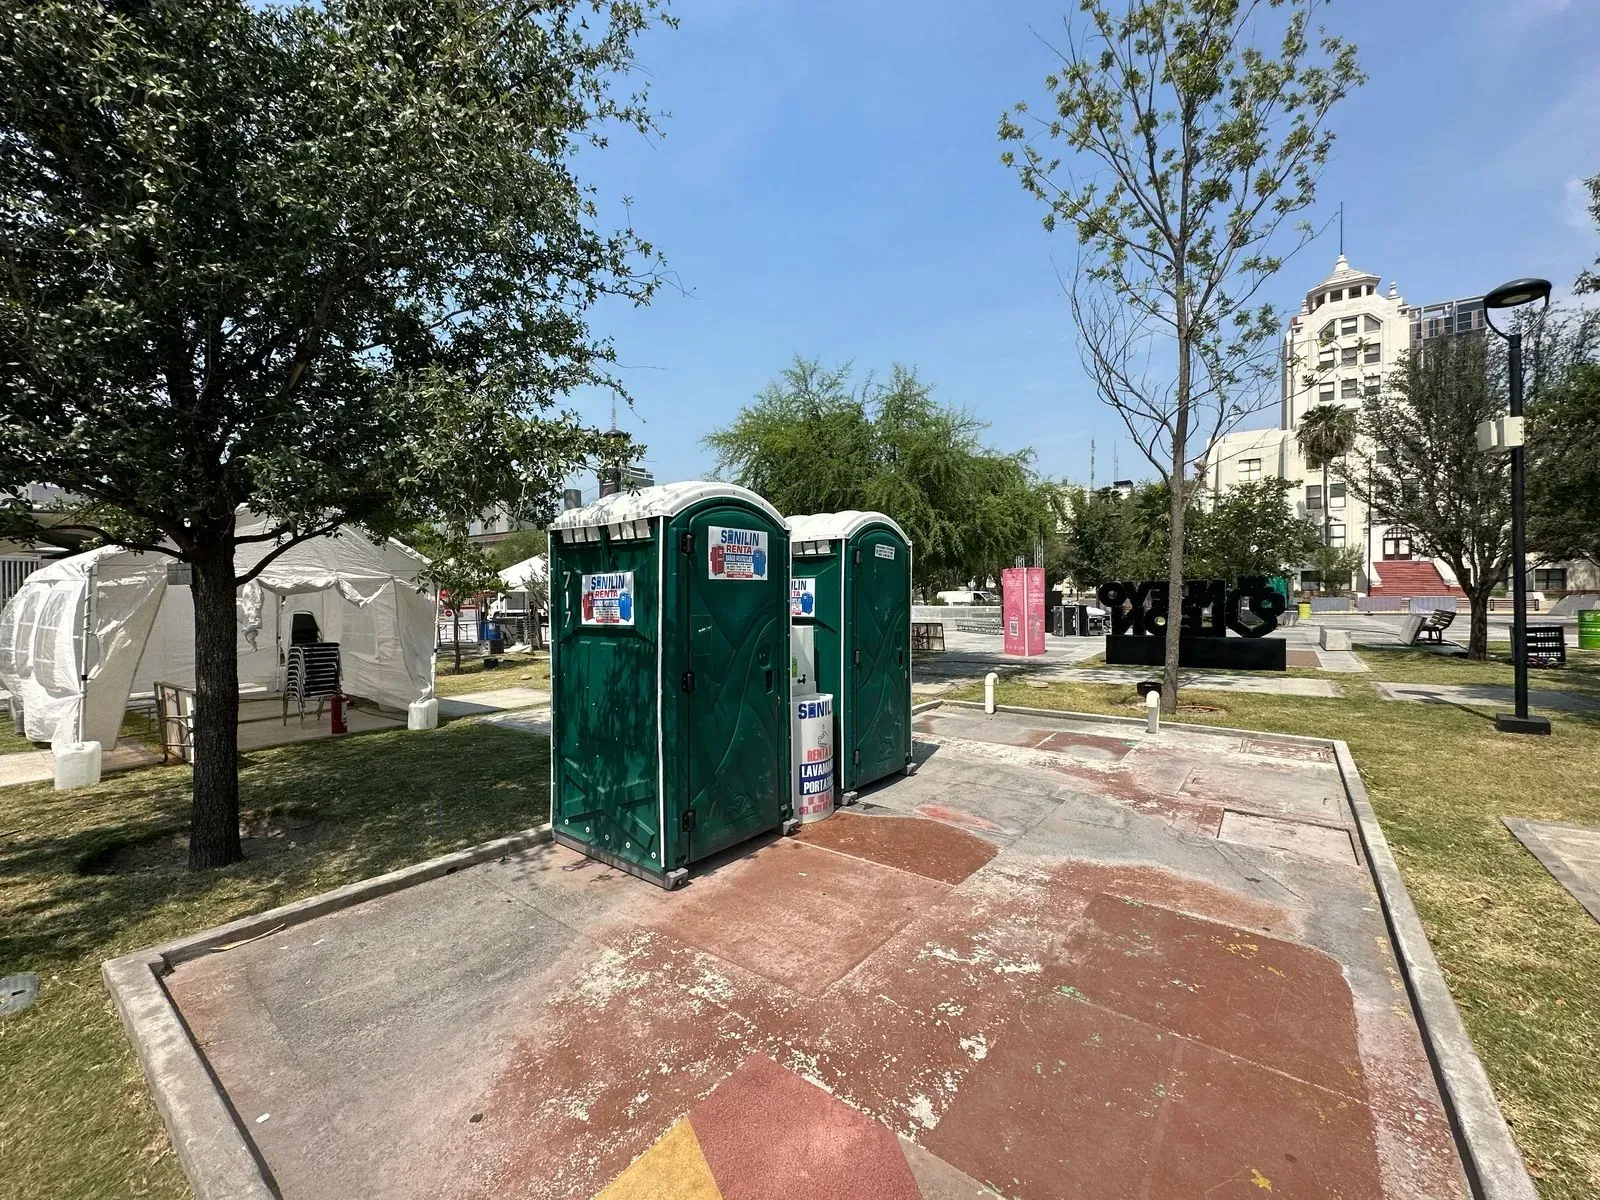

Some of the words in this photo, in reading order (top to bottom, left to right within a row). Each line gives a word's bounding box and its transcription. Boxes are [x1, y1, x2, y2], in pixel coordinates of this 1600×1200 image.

[726, 545, 752, 554] RENTA
[595, 590, 618, 598] RENTA
[804, 774, 831, 794] PORTA
